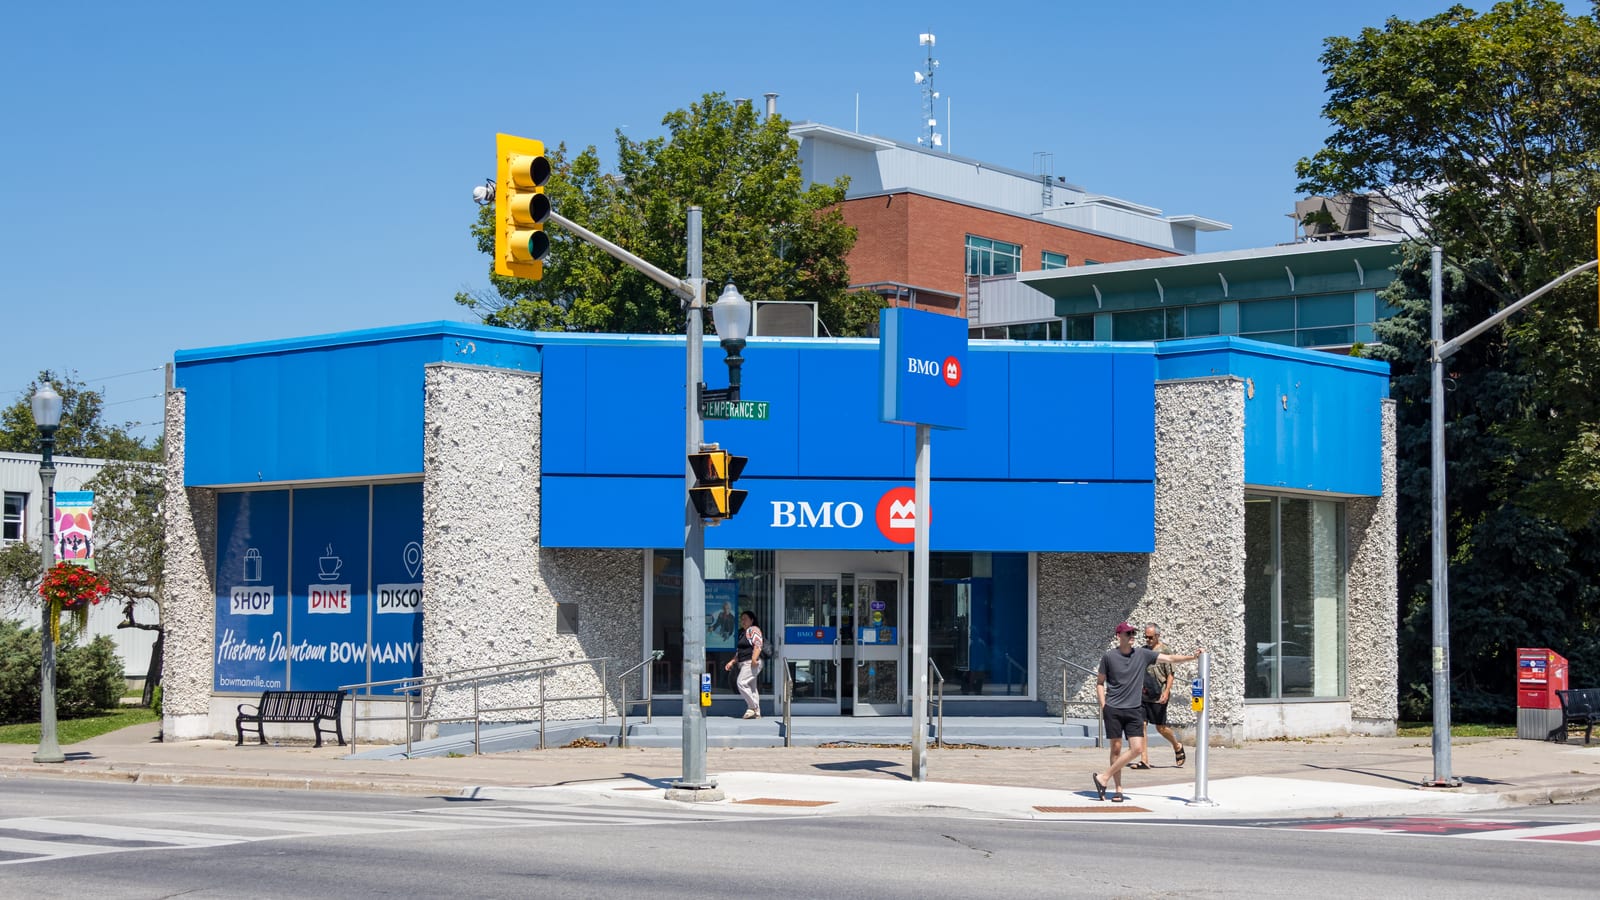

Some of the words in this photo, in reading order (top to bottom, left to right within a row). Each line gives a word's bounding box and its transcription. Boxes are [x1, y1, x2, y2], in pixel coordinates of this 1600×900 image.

[907, 357, 939, 377] BMO
[705, 401, 754, 418] TEMPERANCE
[757, 403, 767, 419] ST
[770, 501, 864, 529] BMO
[234, 591, 271, 610] SHOP
[311, 590, 347, 609] DINE
[218, 628, 266, 664] Historic
[220, 673, 281, 688] bowmanville.com
